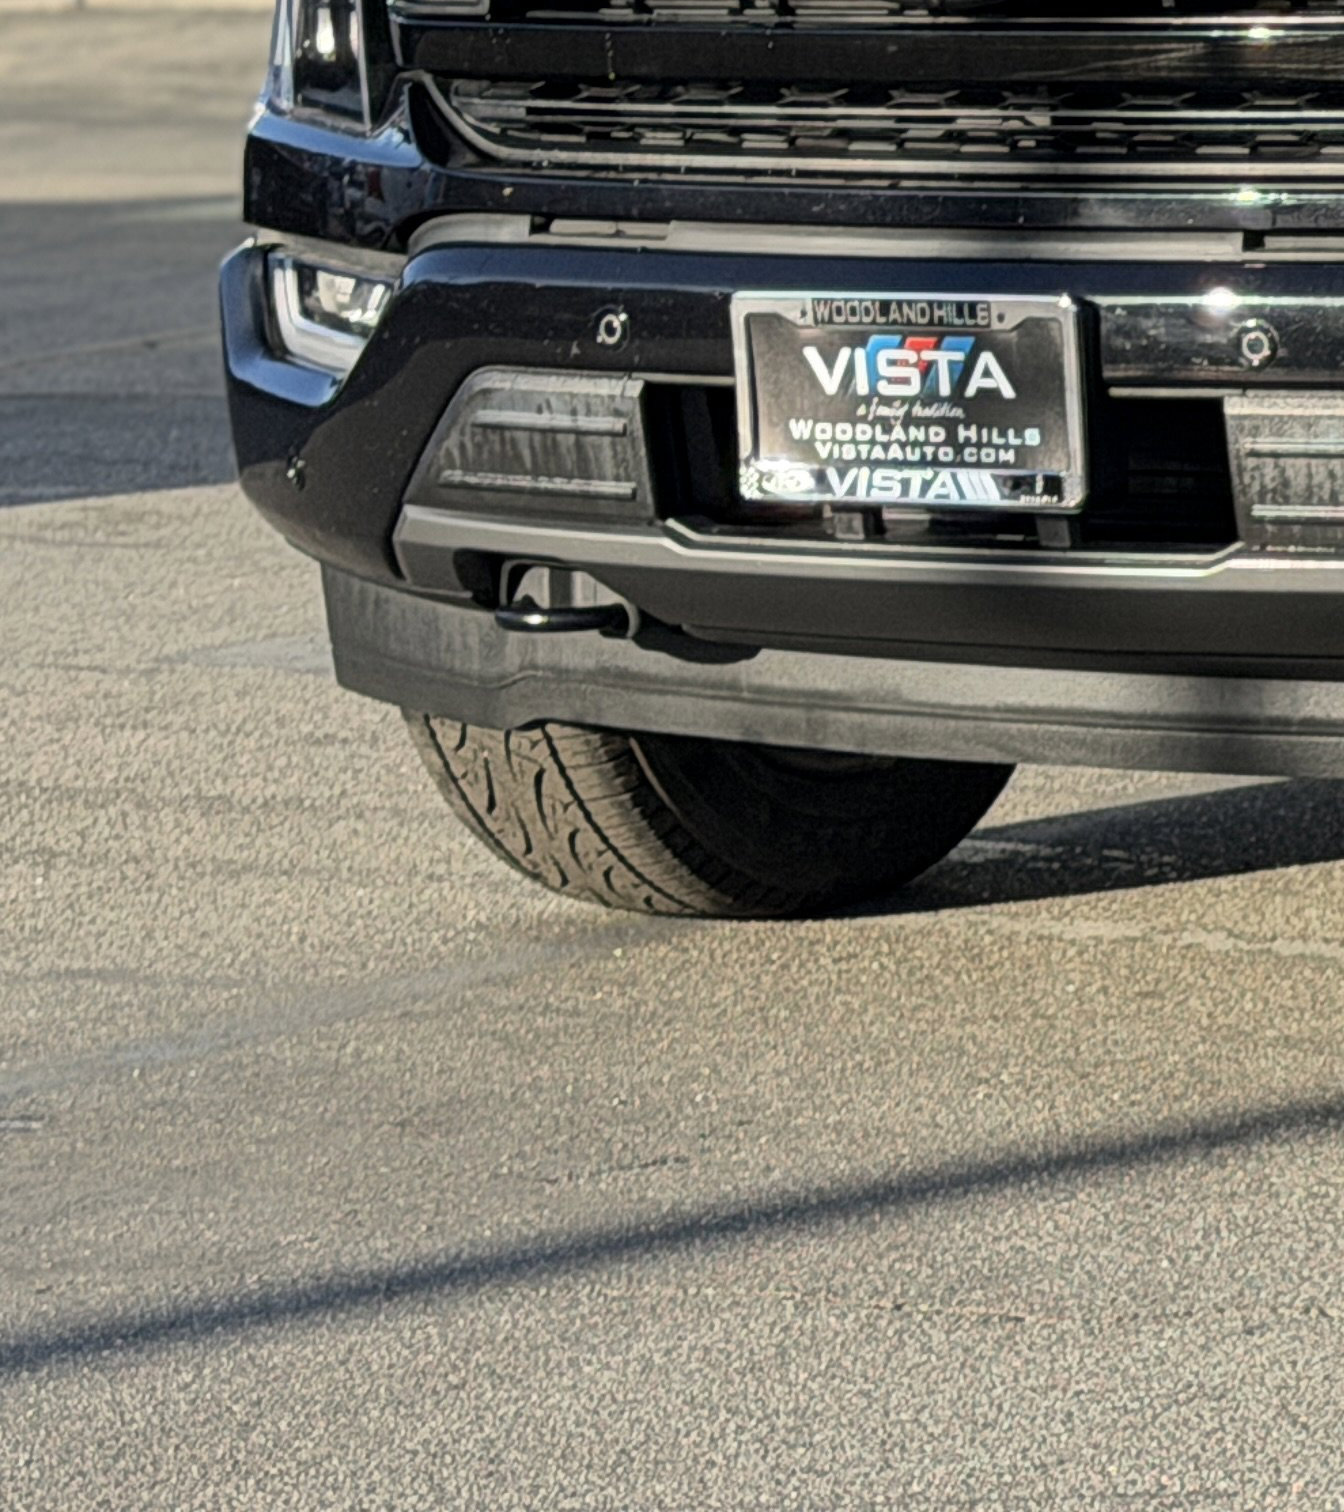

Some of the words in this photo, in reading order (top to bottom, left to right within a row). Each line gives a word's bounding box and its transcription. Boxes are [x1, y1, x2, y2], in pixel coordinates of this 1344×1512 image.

[813, 299, 930, 325] WOODLAND
[933, 301, 990, 327] HILLS
[803, 345, 1016, 400] VISTA
[789, 418, 946, 444] WOODLAND
[958, 423, 1041, 446] HILLS
[826, 466, 958, 500] VISTA
